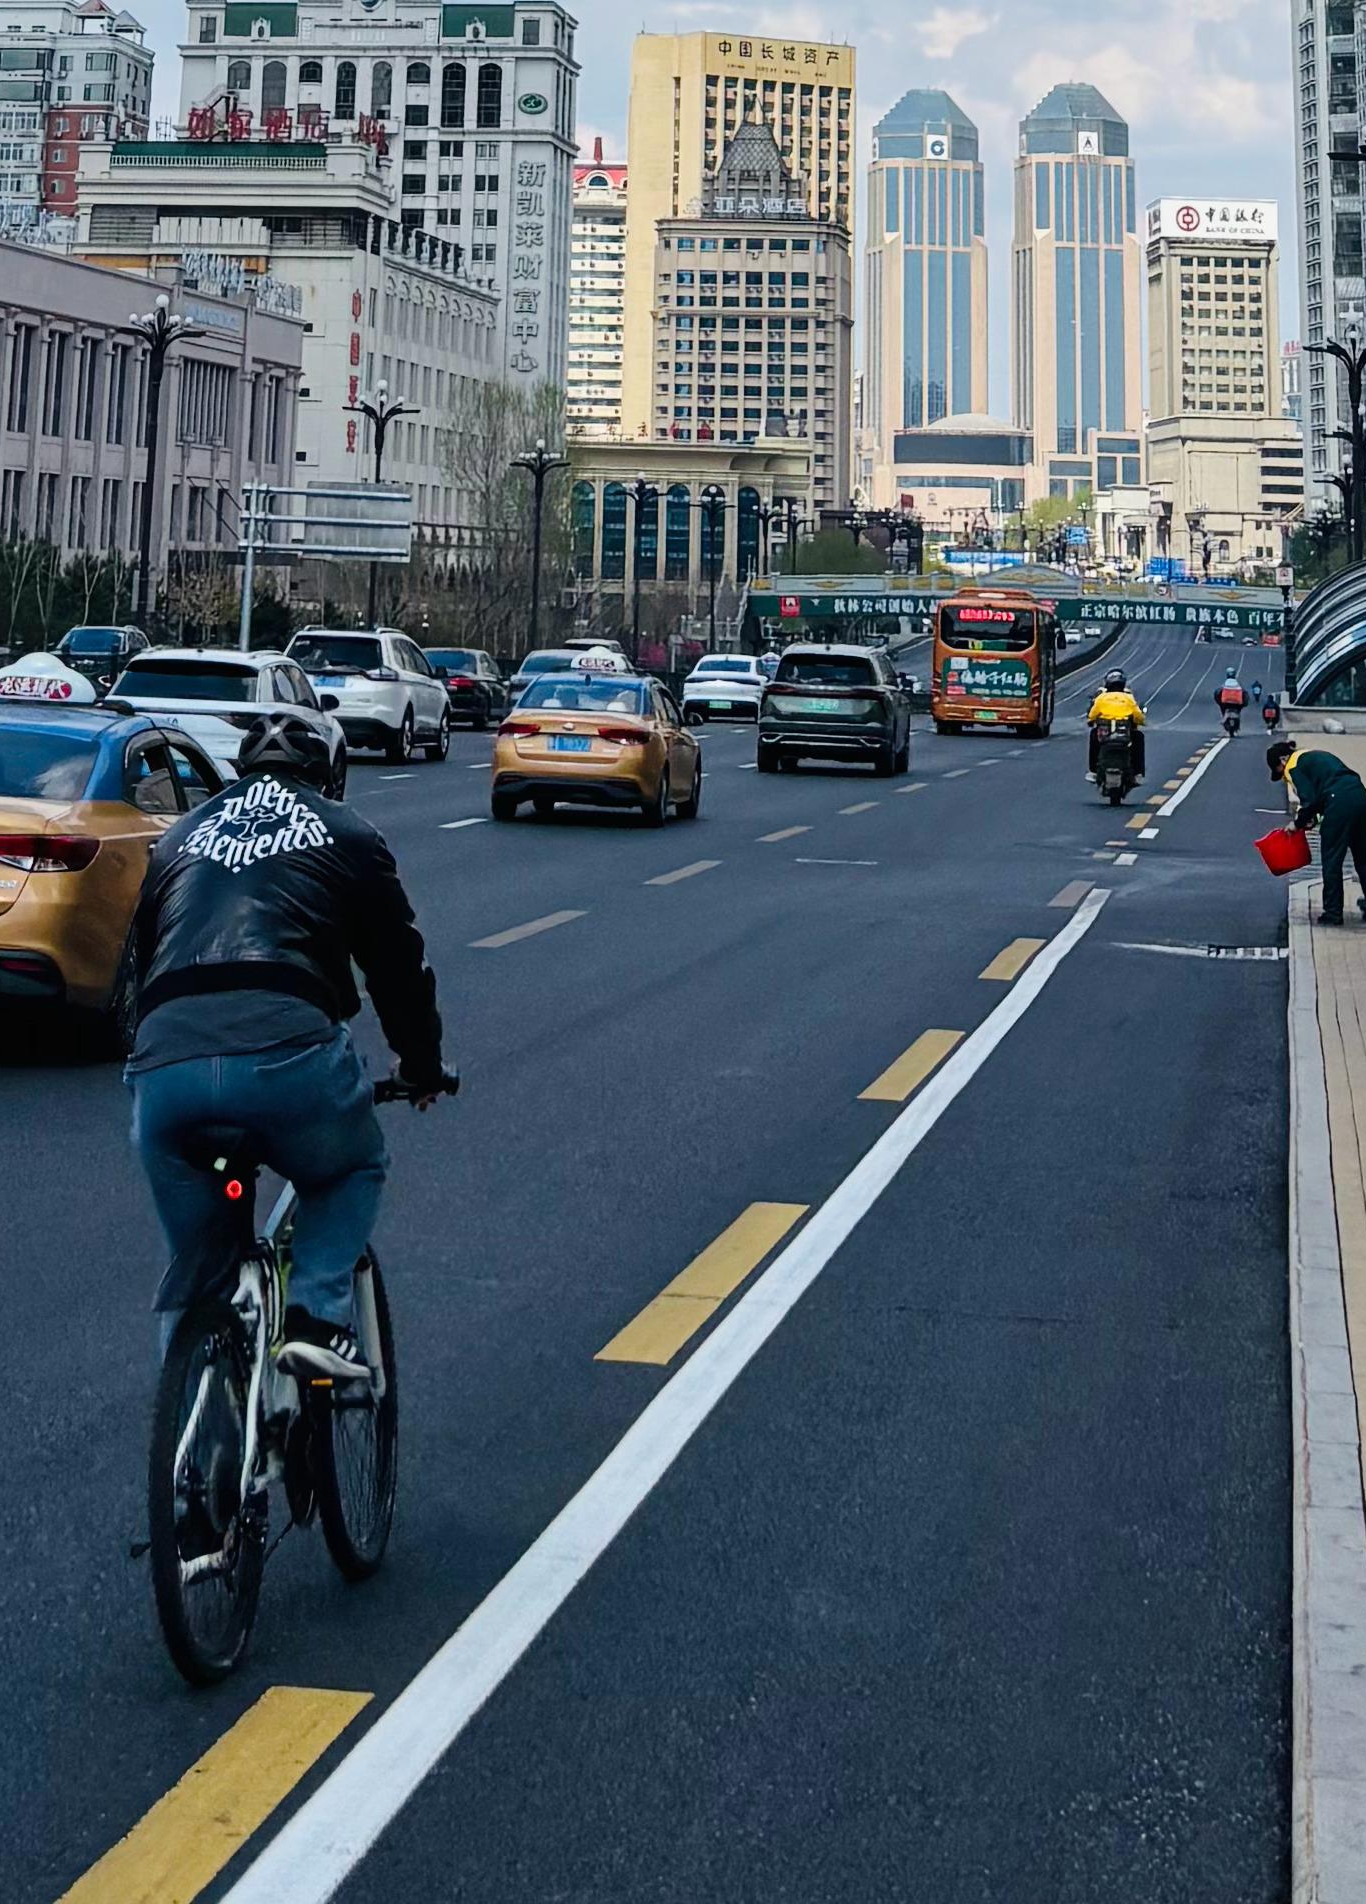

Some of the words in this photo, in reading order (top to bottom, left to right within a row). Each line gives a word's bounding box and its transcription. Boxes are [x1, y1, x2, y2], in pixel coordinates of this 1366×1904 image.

[718, 39, 840, 66] 中国长城资产
[712, 195, 808, 215] 亚朵酒店
[1205, 206, 1265, 224] 中国银行
[510, 160, 546, 373] 新凯莱财富中心
